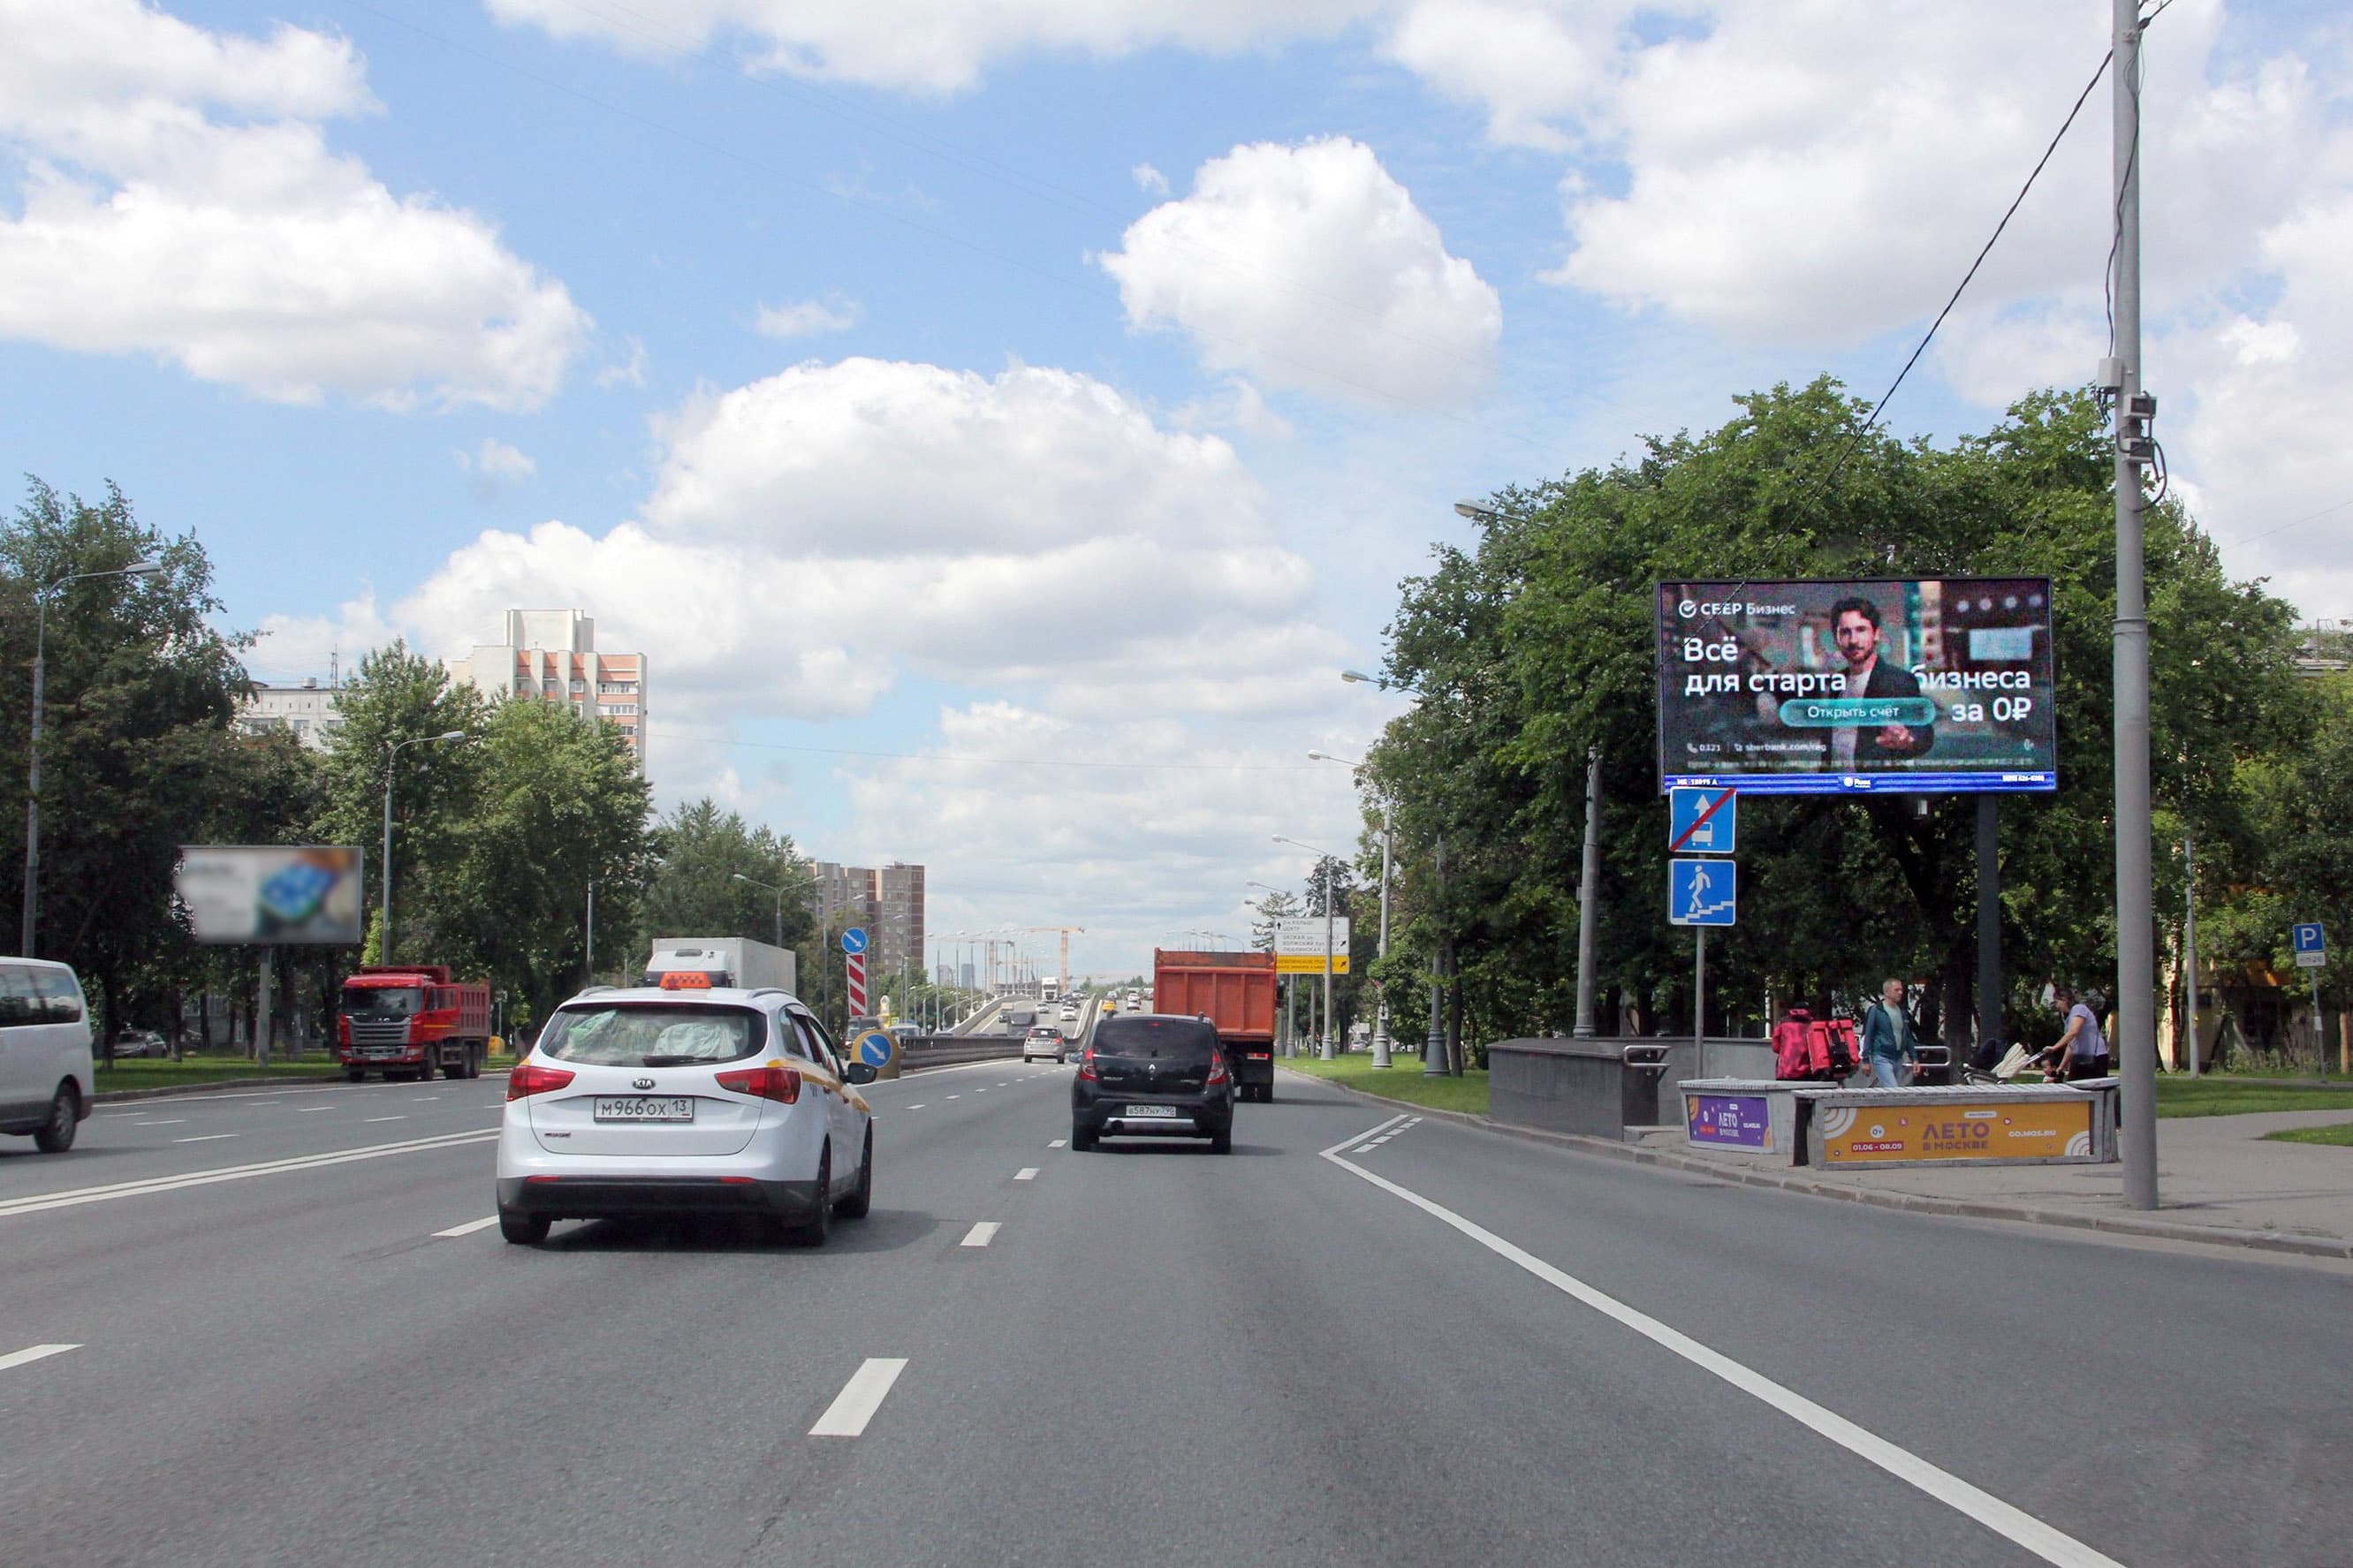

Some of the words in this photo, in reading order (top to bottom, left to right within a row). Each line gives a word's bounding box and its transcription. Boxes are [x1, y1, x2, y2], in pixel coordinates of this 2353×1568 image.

[1746, 602, 1796, 616] Бизнес
[1683, 635, 1739, 663] Всё
[1684, 673, 1741, 697] для
[1748, 672, 1848, 698] старта
[1910, 663, 2031, 690] бизнеса
[1807, 705, 1866, 720] Открыть
[1869, 704, 1900, 717] счёт
[1951, 702, 1984, 722] за
[634, 1079, 653, 1087] KIA
[1718, 1111, 1738, 1128] ЛЕТО
[1922, 1121, 1991, 1140] ЛЕТО
[1852, 1143, 1874, 1152] 01.06
[1879, 1142, 1903, 1151] 08.09
[1922, 1142, 1930, 1151] В
[1931, 1140, 1988, 1151] МОСКВЕ
